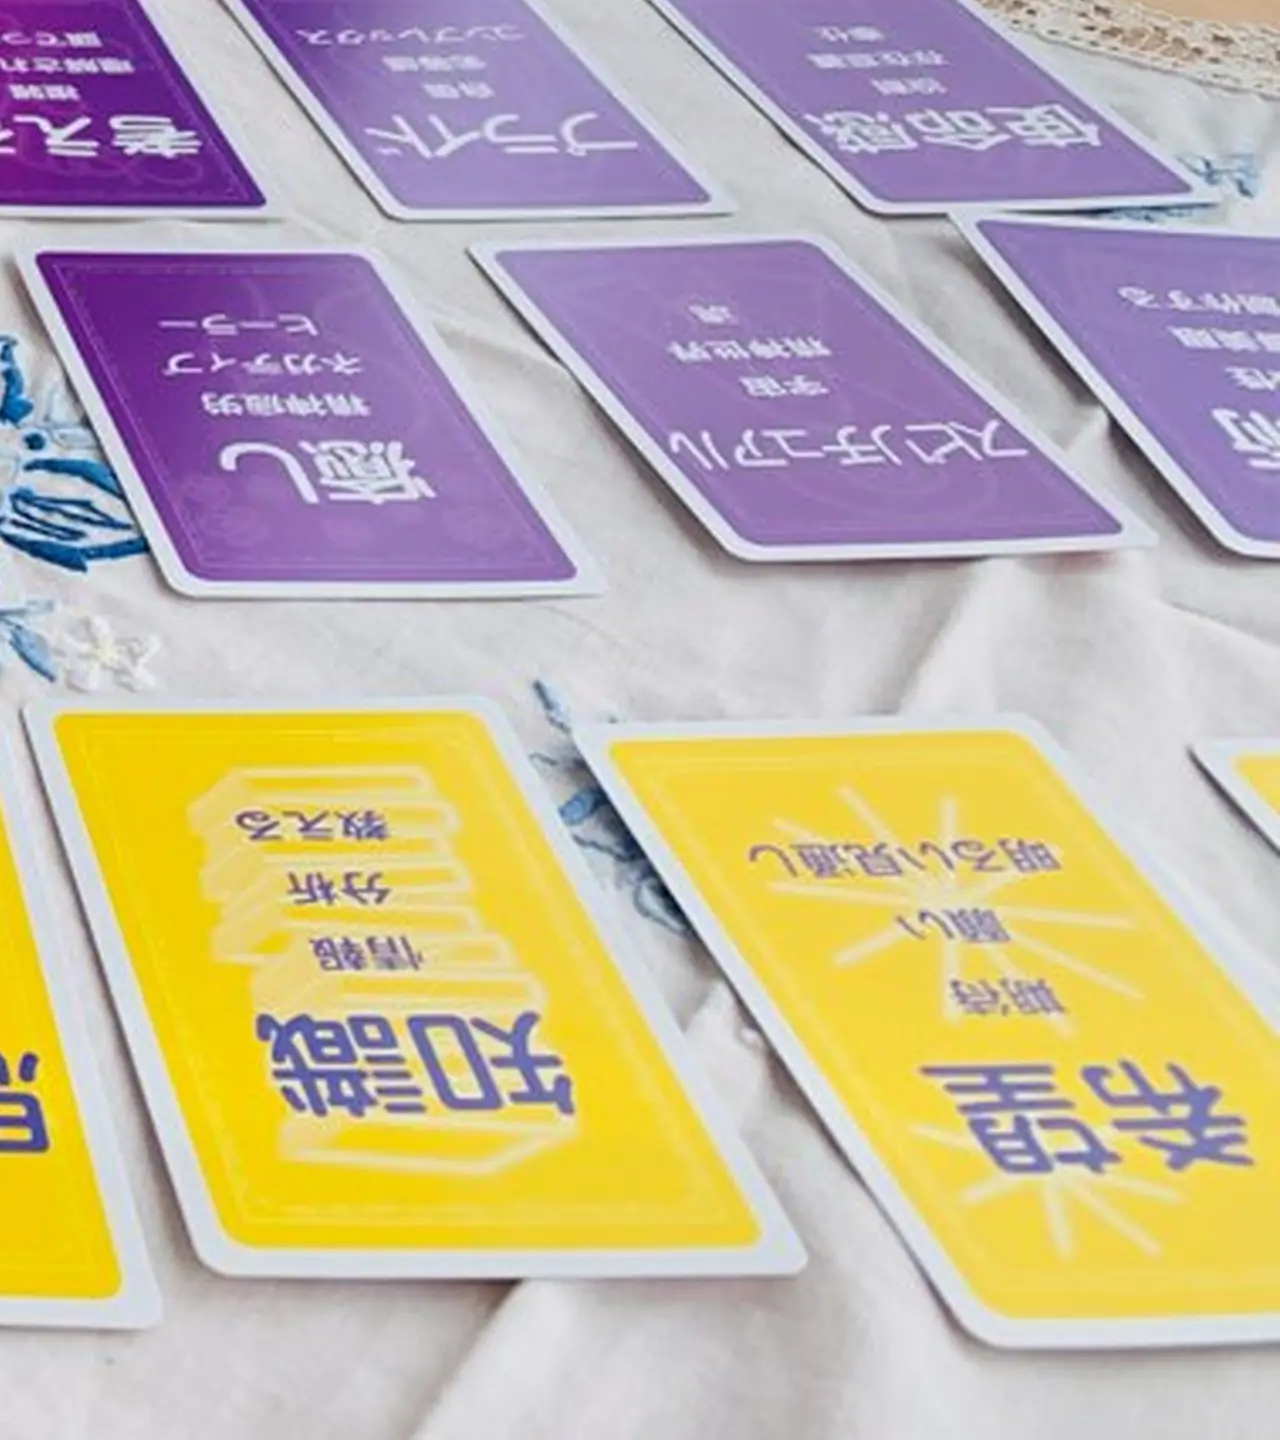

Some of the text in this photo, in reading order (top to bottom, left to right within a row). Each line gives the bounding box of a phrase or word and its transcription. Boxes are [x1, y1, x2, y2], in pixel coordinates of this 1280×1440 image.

[296, 24, 525, 45] コンプレックス
[365, 112, 638, 159] プライド
[803, 103, 1102, 153] 使命感
[158, 313, 319, 336] ヒーラー
[162, 352, 363, 376] ネガティブ
[667, 337, 832, 361] 精神世界
[739, 374, 828, 397] 宇宙
[201, 392, 371, 417] 精神疲労
[669, 420, 1028, 471] スピリチュアル
[219, 440, 436, 505] 癒し
[235, 809, 390, 841] 教える
[748, 838, 1062, 879] 明るい見通し
[286, 871, 392, 905] 分析
[894, 909, 1011, 943] 願い
[310, 936, 424, 971] 情報
[949, 978, 1069, 1016] 期待
[256, 1012, 575, 1116] 知識
[918, 1060, 1255, 1175] 希望
